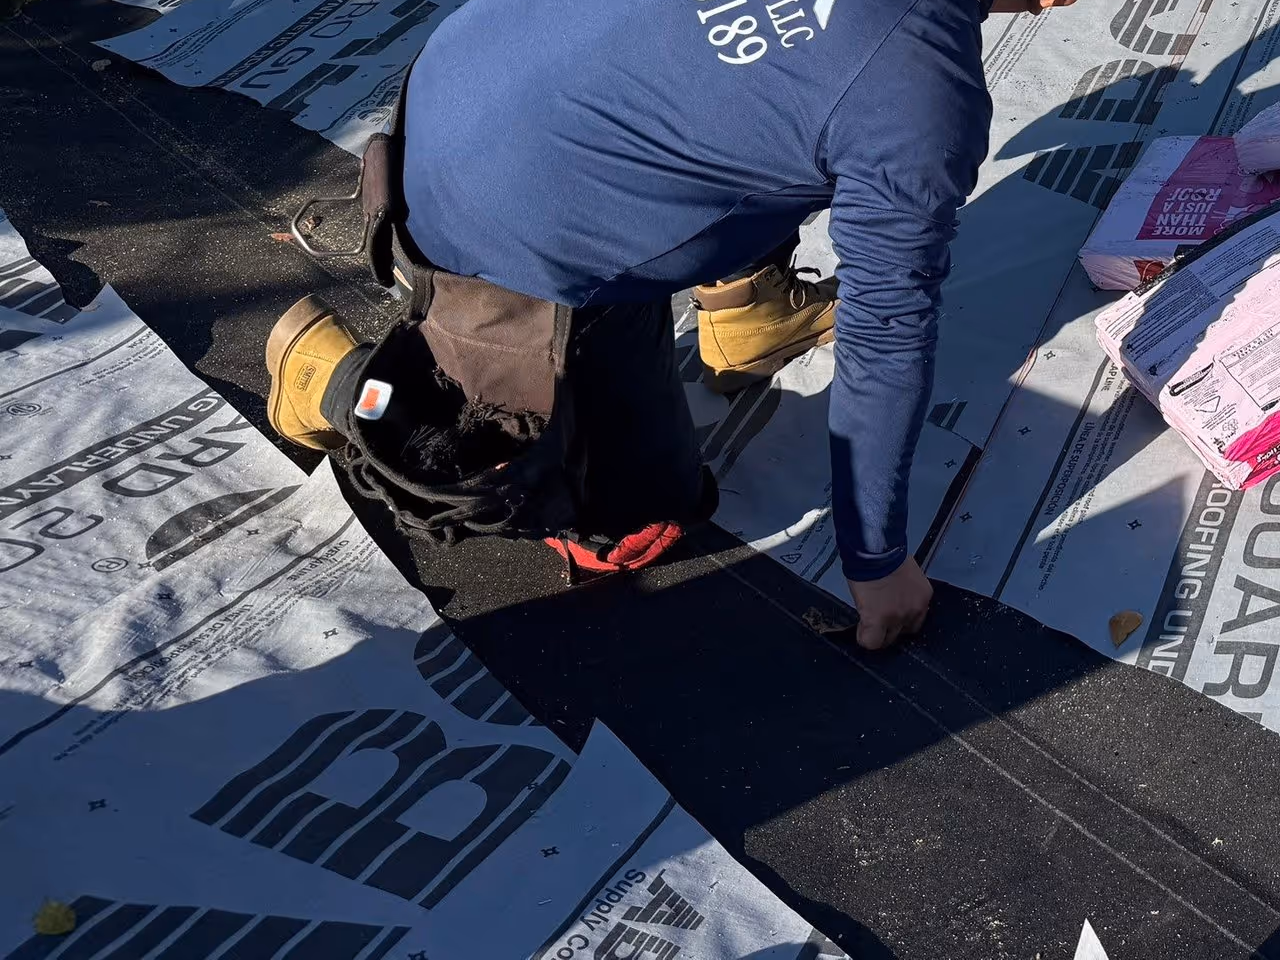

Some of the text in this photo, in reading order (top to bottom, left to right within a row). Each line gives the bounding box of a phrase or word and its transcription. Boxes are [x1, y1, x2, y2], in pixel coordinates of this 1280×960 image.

[1163, 202, 1216, 214] JUST A
[1156, 214, 1207, 226] THAN
[1152, 226, 1205, 236] MORE
[579, 868, 647, 932] Supply
[593, 868, 706, 960] AB
